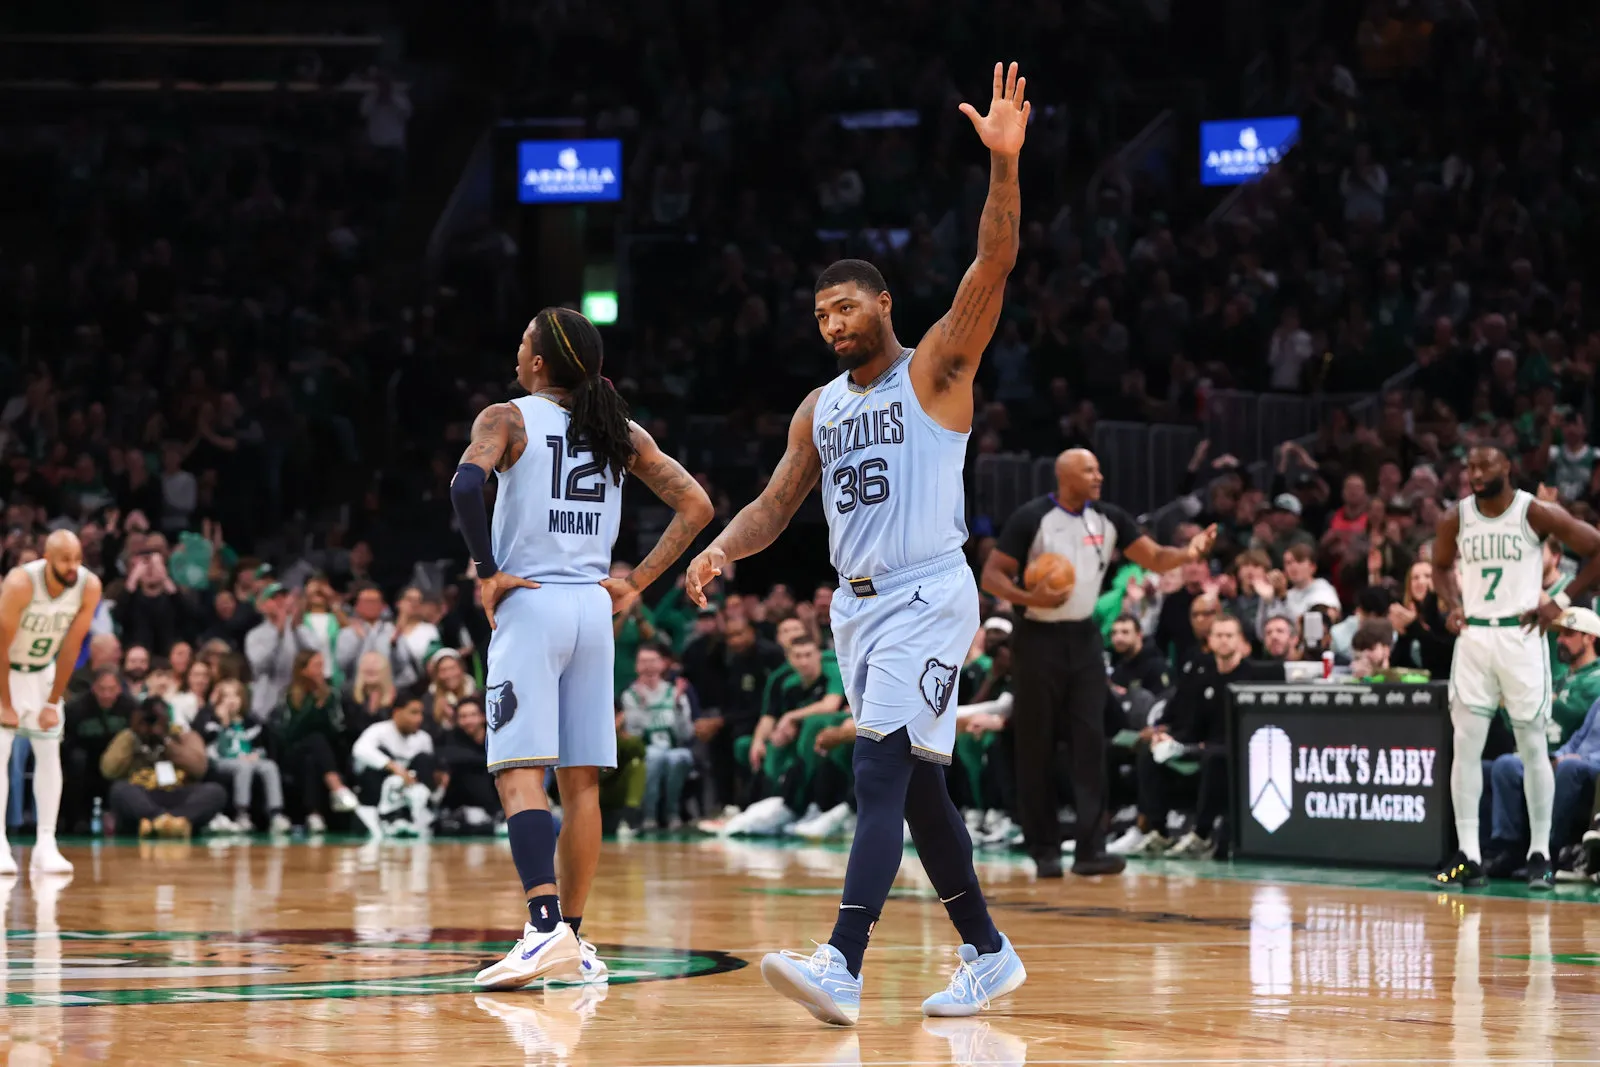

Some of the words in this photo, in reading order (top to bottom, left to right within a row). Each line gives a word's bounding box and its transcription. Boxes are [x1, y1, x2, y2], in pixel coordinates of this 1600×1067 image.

[818, 401, 904, 469] GRIZZLIES
[546, 435, 606, 503] 12
[833, 457, 890, 515] 36
[549, 509, 602, 536] MORANT
[1462, 533, 1522, 564] CELTICS
[1481, 567, 1503, 601] 7
[28, 637, 53, 657] 9
[1294, 745, 1371, 785] JACK'S
[1373, 747, 1436, 787] ABBY
[1304, 790, 1359, 820] CRAFT
[1360, 792, 1426, 823] LAGERS
